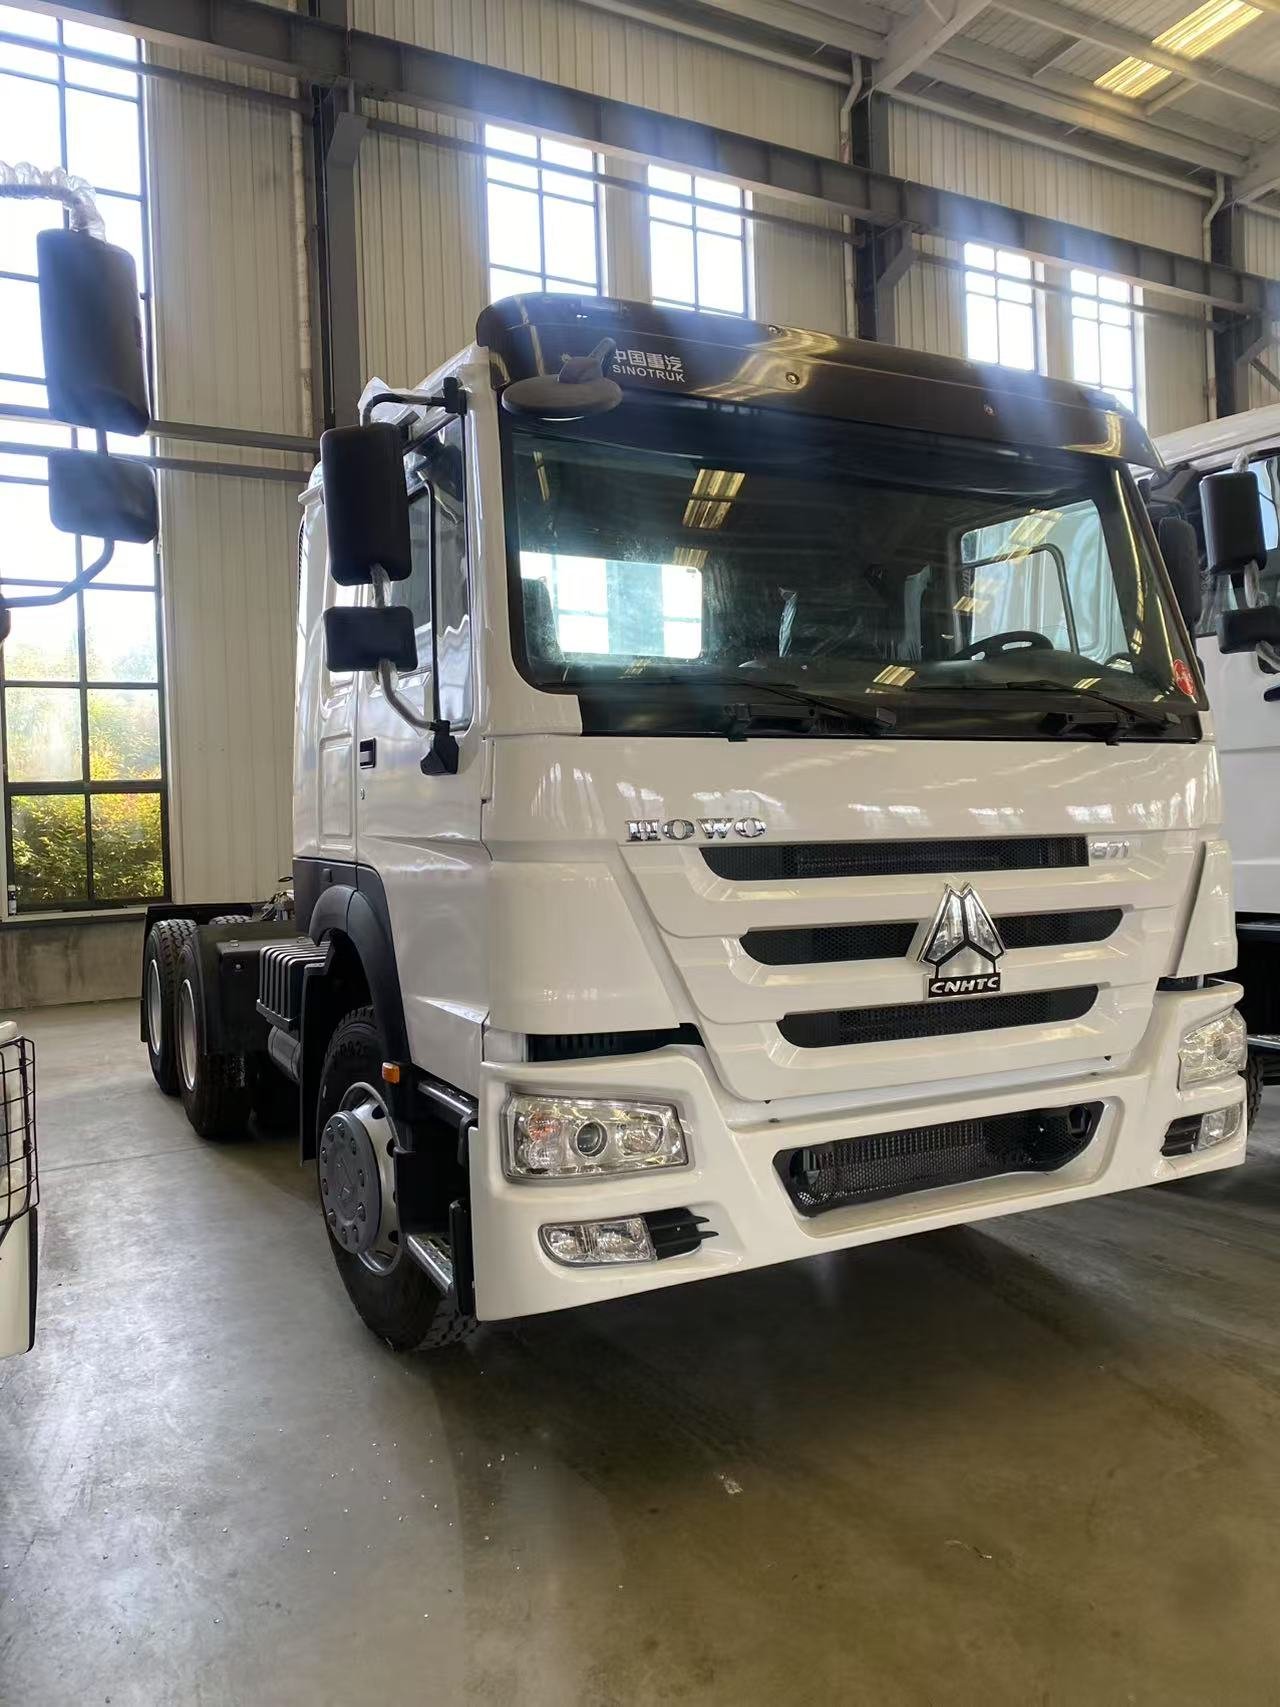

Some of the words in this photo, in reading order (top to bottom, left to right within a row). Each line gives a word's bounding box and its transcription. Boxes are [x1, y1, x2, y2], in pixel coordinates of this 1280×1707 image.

[614, 349, 684, 372] 中国重汽
[612, 364, 686, 383] SINOTRUK
[625, 817, 767, 842] HOWO
[930, 977, 999, 993] CNHTC
